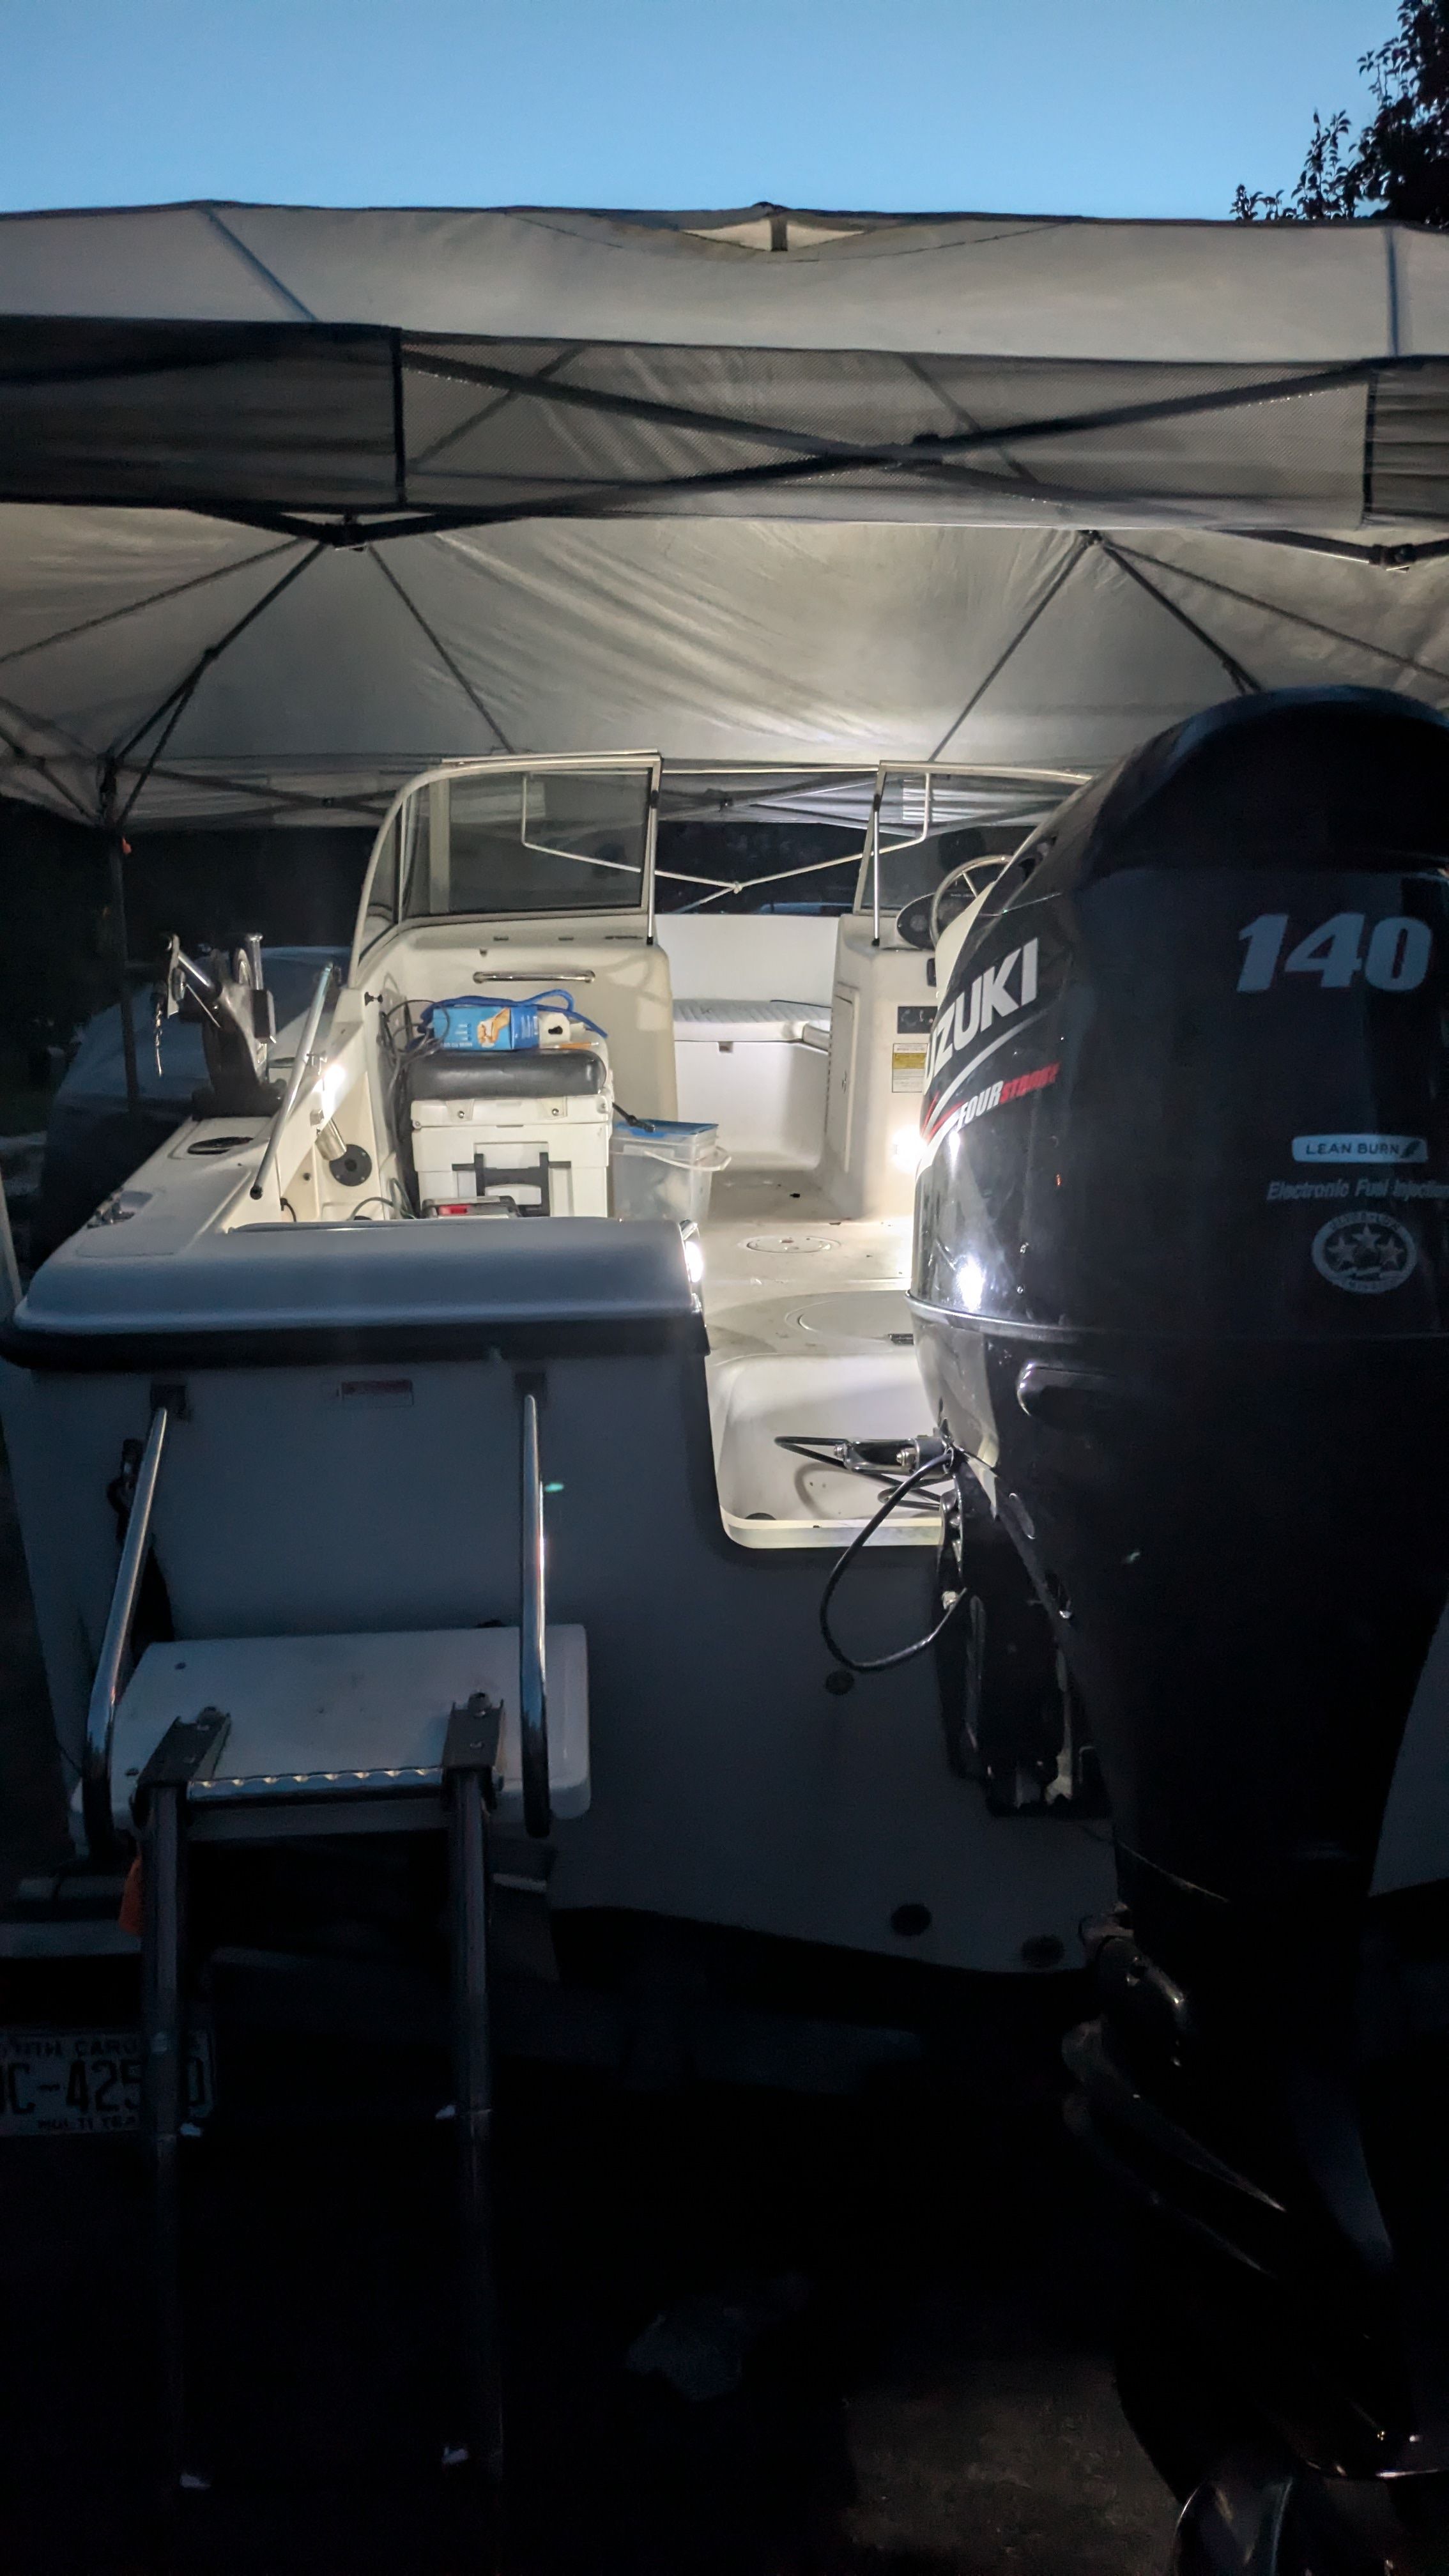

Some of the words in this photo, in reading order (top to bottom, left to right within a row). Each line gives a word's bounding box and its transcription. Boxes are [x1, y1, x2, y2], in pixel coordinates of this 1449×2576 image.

[1236, 912, 1433, 993] 140
[924, 937, 1038, 1095] UZUKI
[1306, 1142, 1352, 1154] LEAN
[1357, 1144, 1399, 1154] BURN
[1266, 1178, 1349, 1200] Electronic
[1354, 1177, 1390, 1198] Fuel
